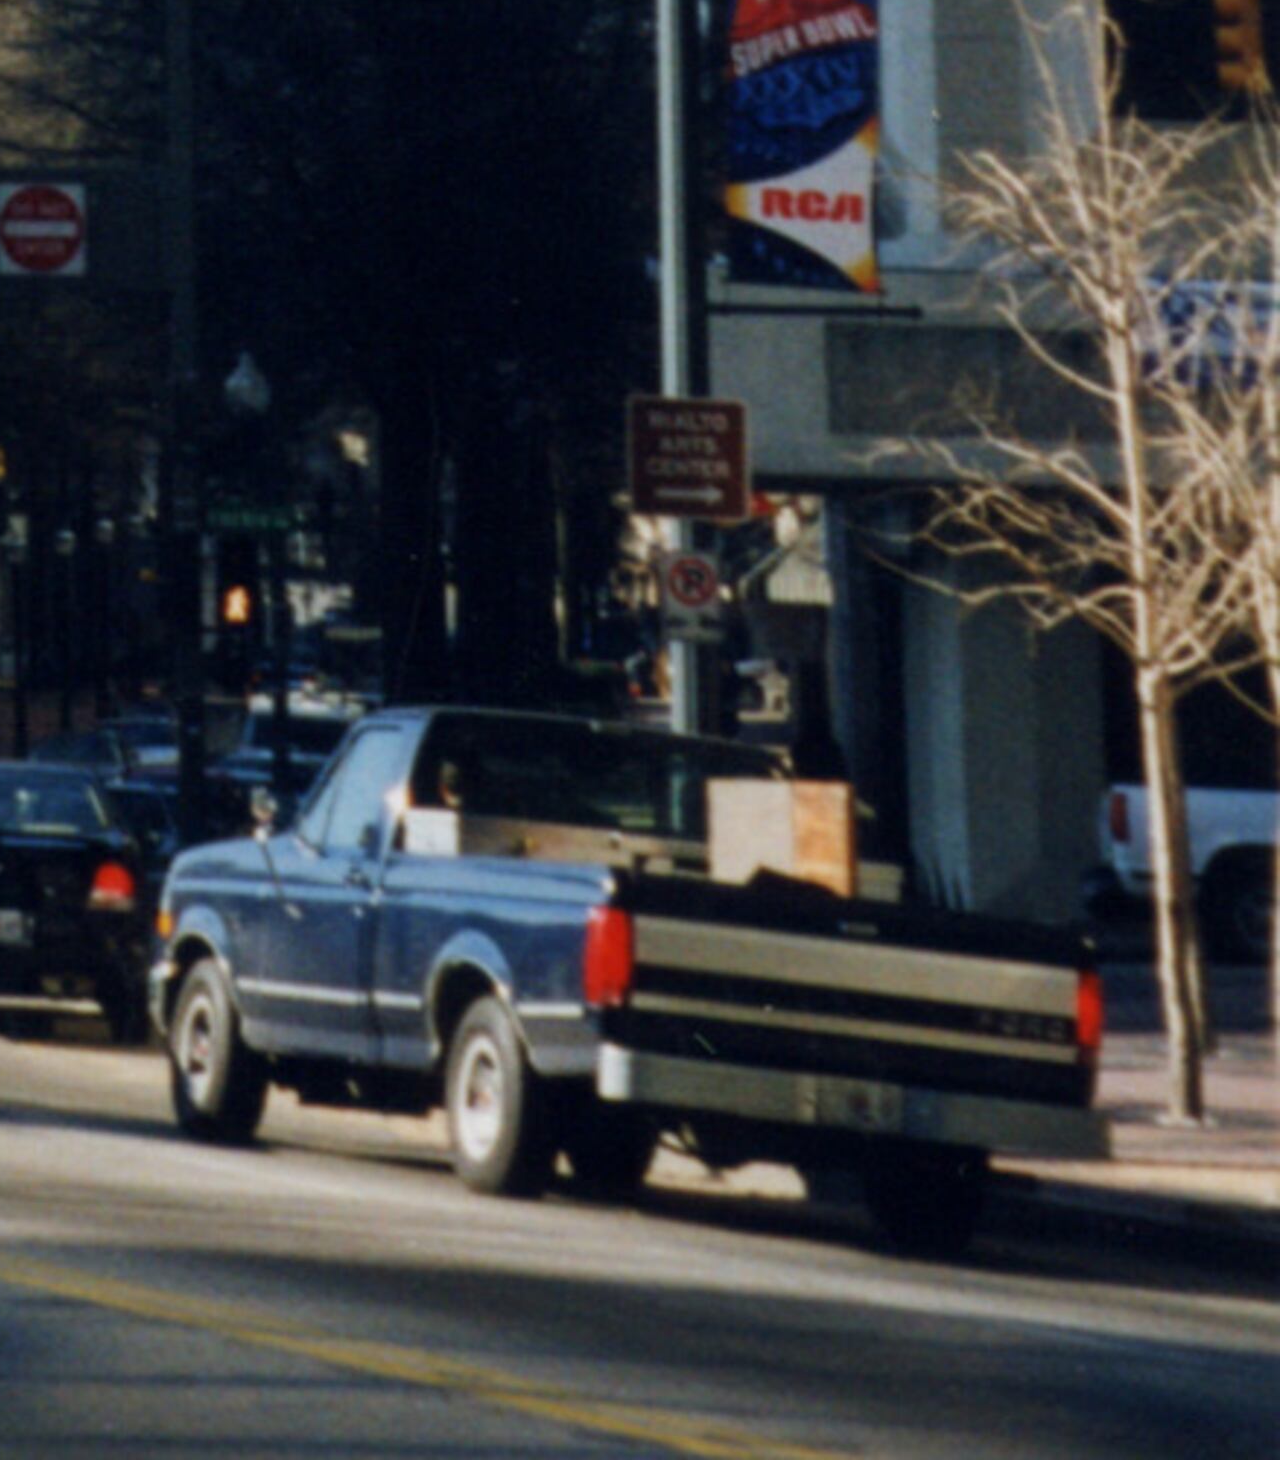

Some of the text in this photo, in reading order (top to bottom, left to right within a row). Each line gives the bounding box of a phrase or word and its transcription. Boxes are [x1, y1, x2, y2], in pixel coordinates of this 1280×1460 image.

[730, 5, 878, 77] SUPER BOWL
[761, 187, 865, 224] RCA
[647, 410, 729, 433] RIALTO
[659, 436, 718, 455] ARTS
[646, 458, 730, 479] CENTER
